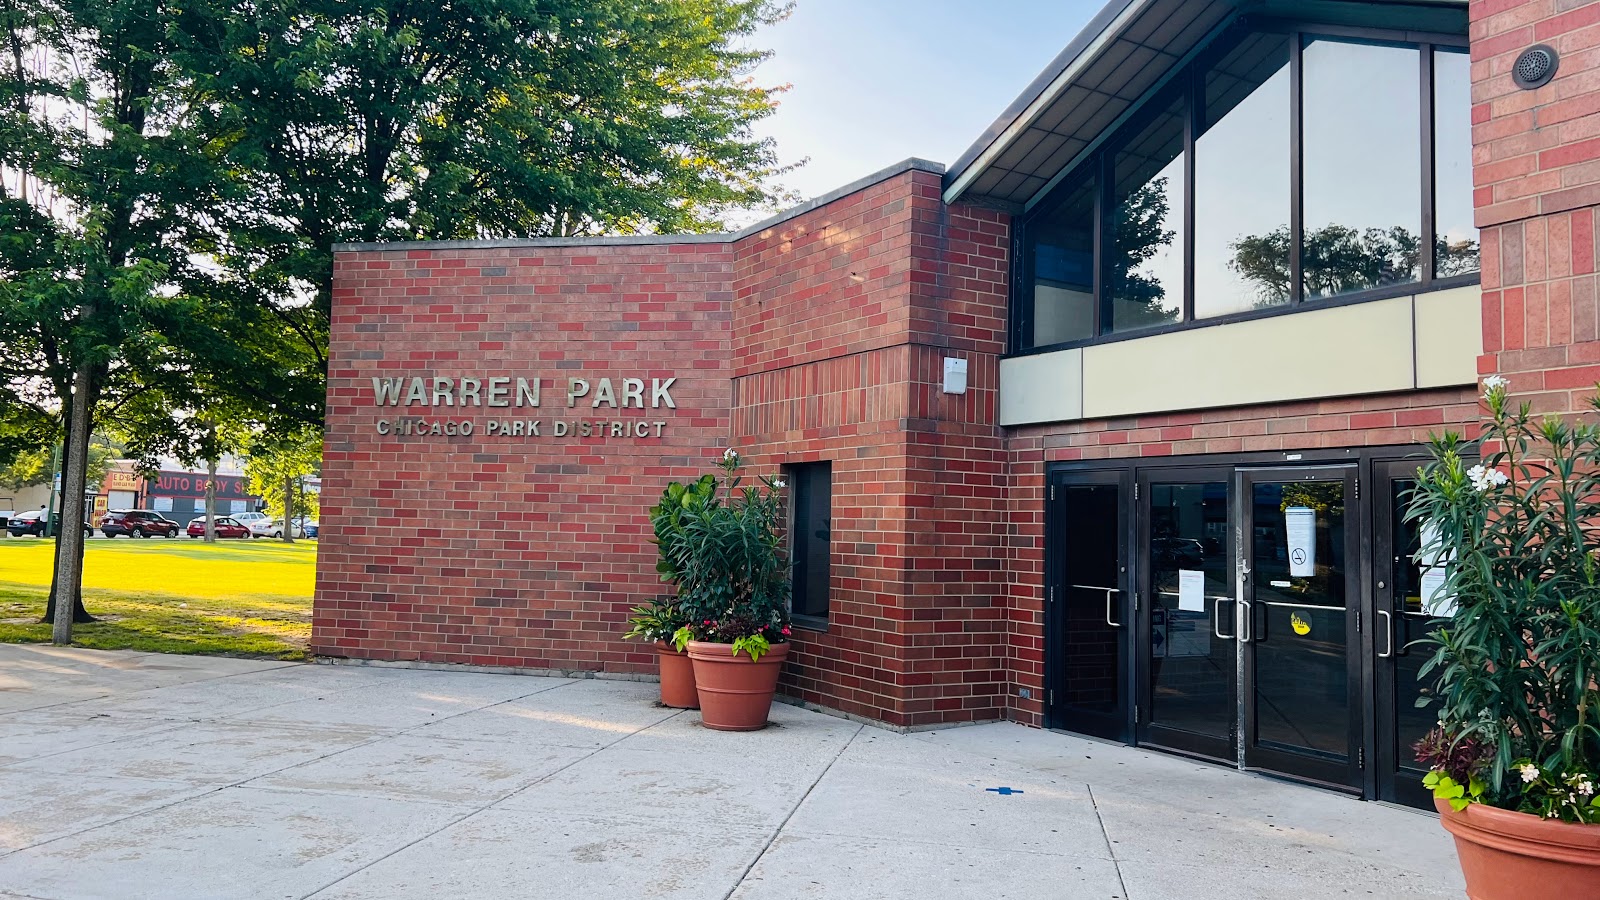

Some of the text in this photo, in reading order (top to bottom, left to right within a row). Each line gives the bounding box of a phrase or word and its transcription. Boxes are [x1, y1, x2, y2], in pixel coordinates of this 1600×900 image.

[371, 376, 677, 409] WARREN PARK
[376, 419, 666, 438] CHICAGO PARK DISTRICT
[154, 476, 190, 491] AUTO
